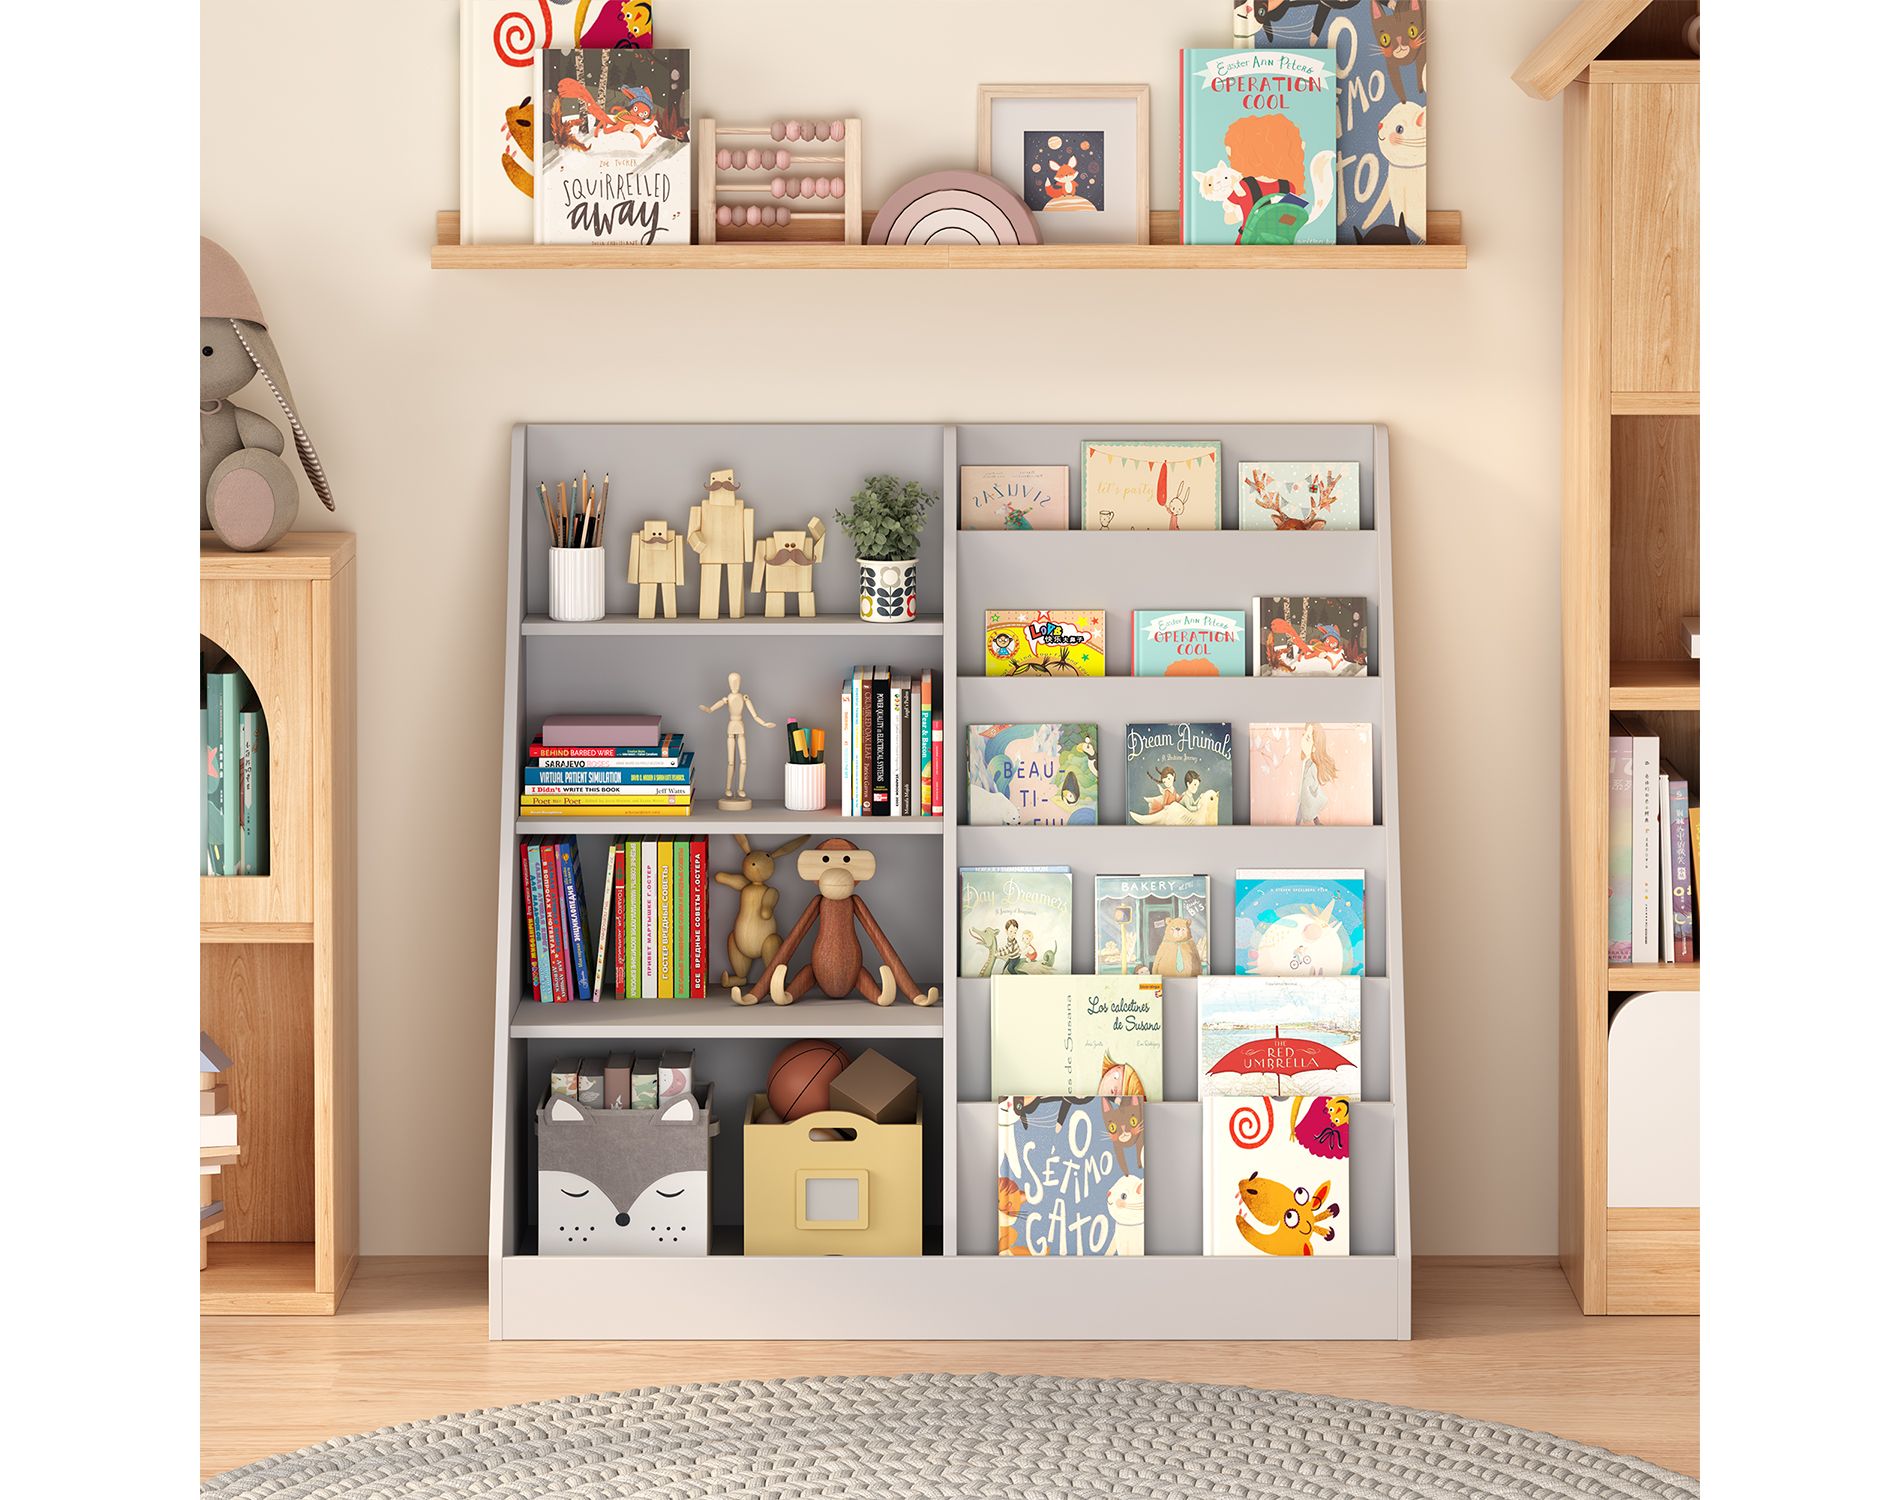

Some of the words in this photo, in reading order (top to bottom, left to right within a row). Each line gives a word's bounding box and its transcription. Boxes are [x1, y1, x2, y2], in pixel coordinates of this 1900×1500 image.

[1217, 59, 1249, 75] Easter
[1211, 77, 1321, 92] OPERATION
[1243, 94, 1290, 110] COOL
[567, 200, 669, 245] away
[1154, 631, 1234, 642] OPERATION
[1177, 643, 1211, 655] COOL
[876, 709, 884, 728] QUALITY
[1128, 728, 1174, 761] Dream
[1177, 723, 1231, 760] Animals
[545, 760, 585, 768] SARAJEVO
[1004, 761, 1065, 779] BEAU-
[540, 771, 564, 783] VIRTUAL
[589, 771, 621, 783] SIMULATION
[1020, 790, 1048, 807] TI-
[1121, 881, 1176, 891] BAKERY
[962, 882, 995, 912] Day
[1002, 878, 1067, 912] Dreamers
[566, 884, 582, 942] ЭНЦИКЛОПЕДИЯ
[1087, 996, 1108, 1015] Los
[1110, 998, 1150, 1012] calcetines
[1113, 1016, 1123, 1030] de
[1125, 1015, 1160, 1031] Susana
[1267, 1047, 1294, 1057] RED
[1244, 1058, 1319, 1070] UMBRELLA
[1067, 1110, 1093, 1157] O
[1023, 1142, 1113, 1204] SÉTIMO
[1026, 1198, 1110, 1256] GATO
